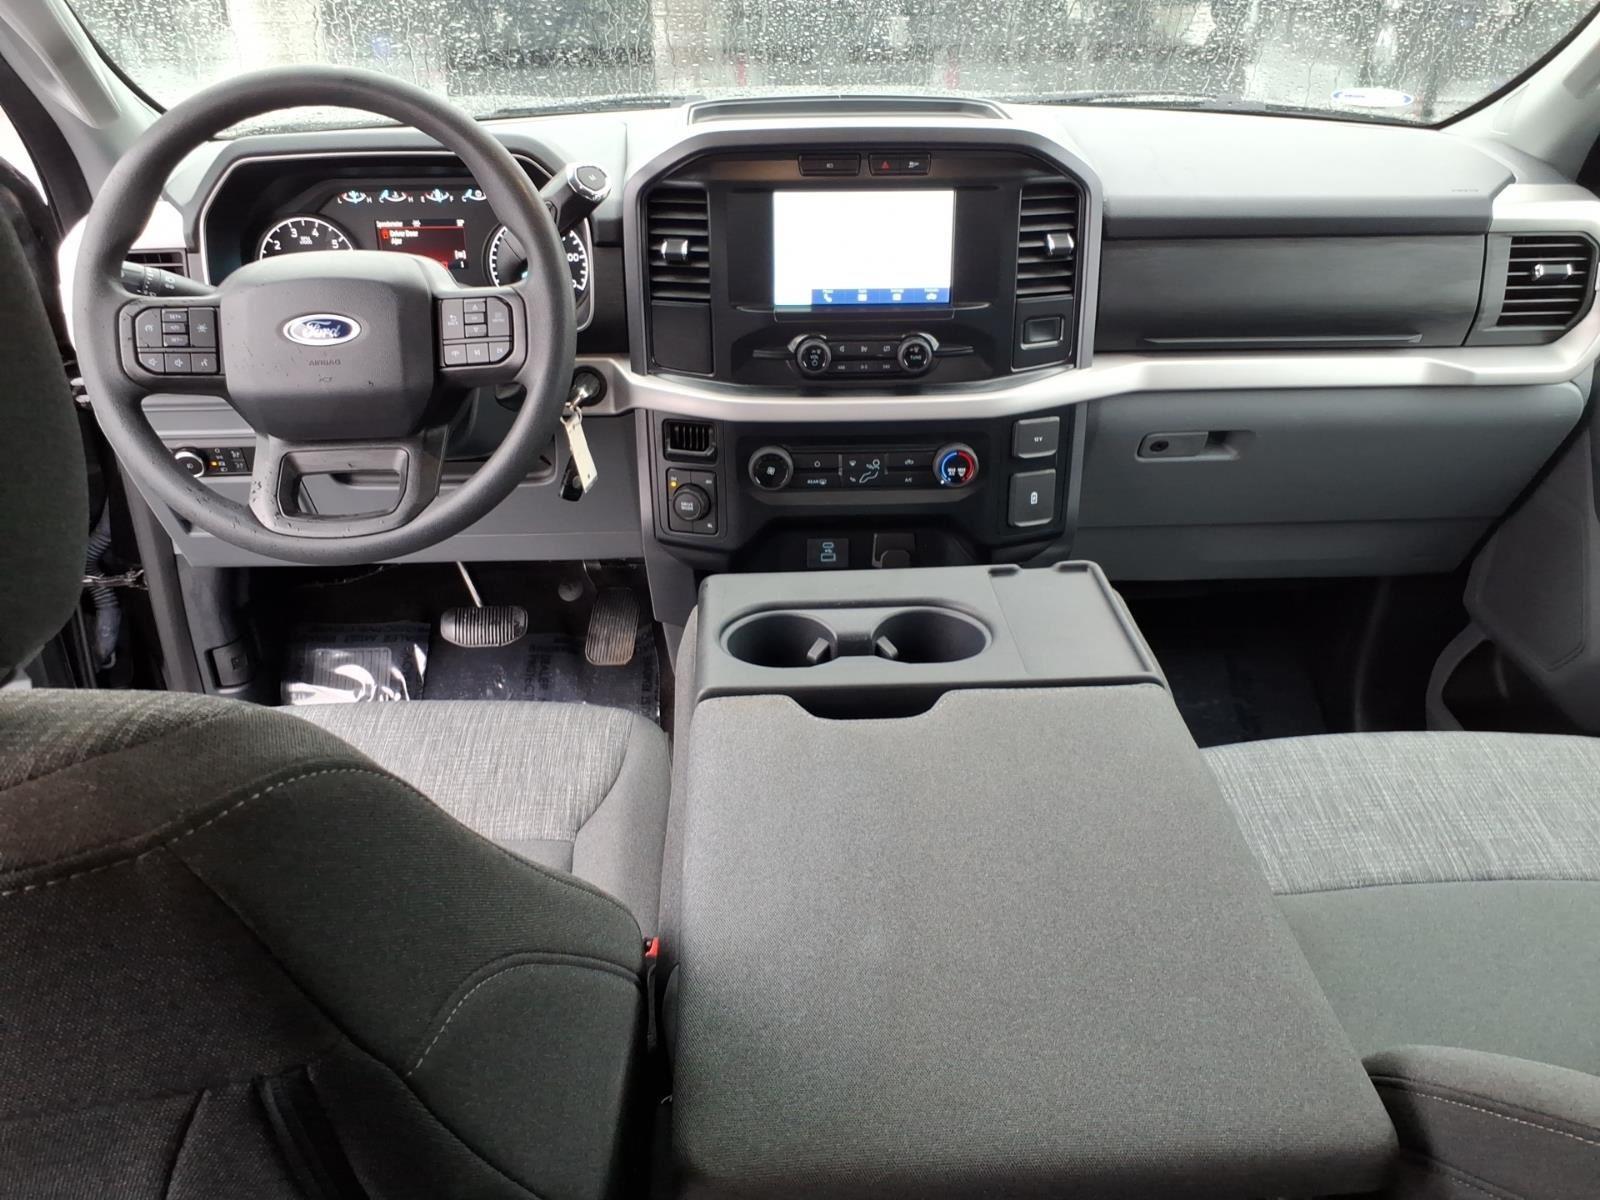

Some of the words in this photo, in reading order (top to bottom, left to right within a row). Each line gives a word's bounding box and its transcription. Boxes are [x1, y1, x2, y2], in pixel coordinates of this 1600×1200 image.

[290, 228, 298, 238] 3
[311, 228, 320, 237] 4
[273, 240, 282, 250] 2
[331, 239, 339, 249] 5
